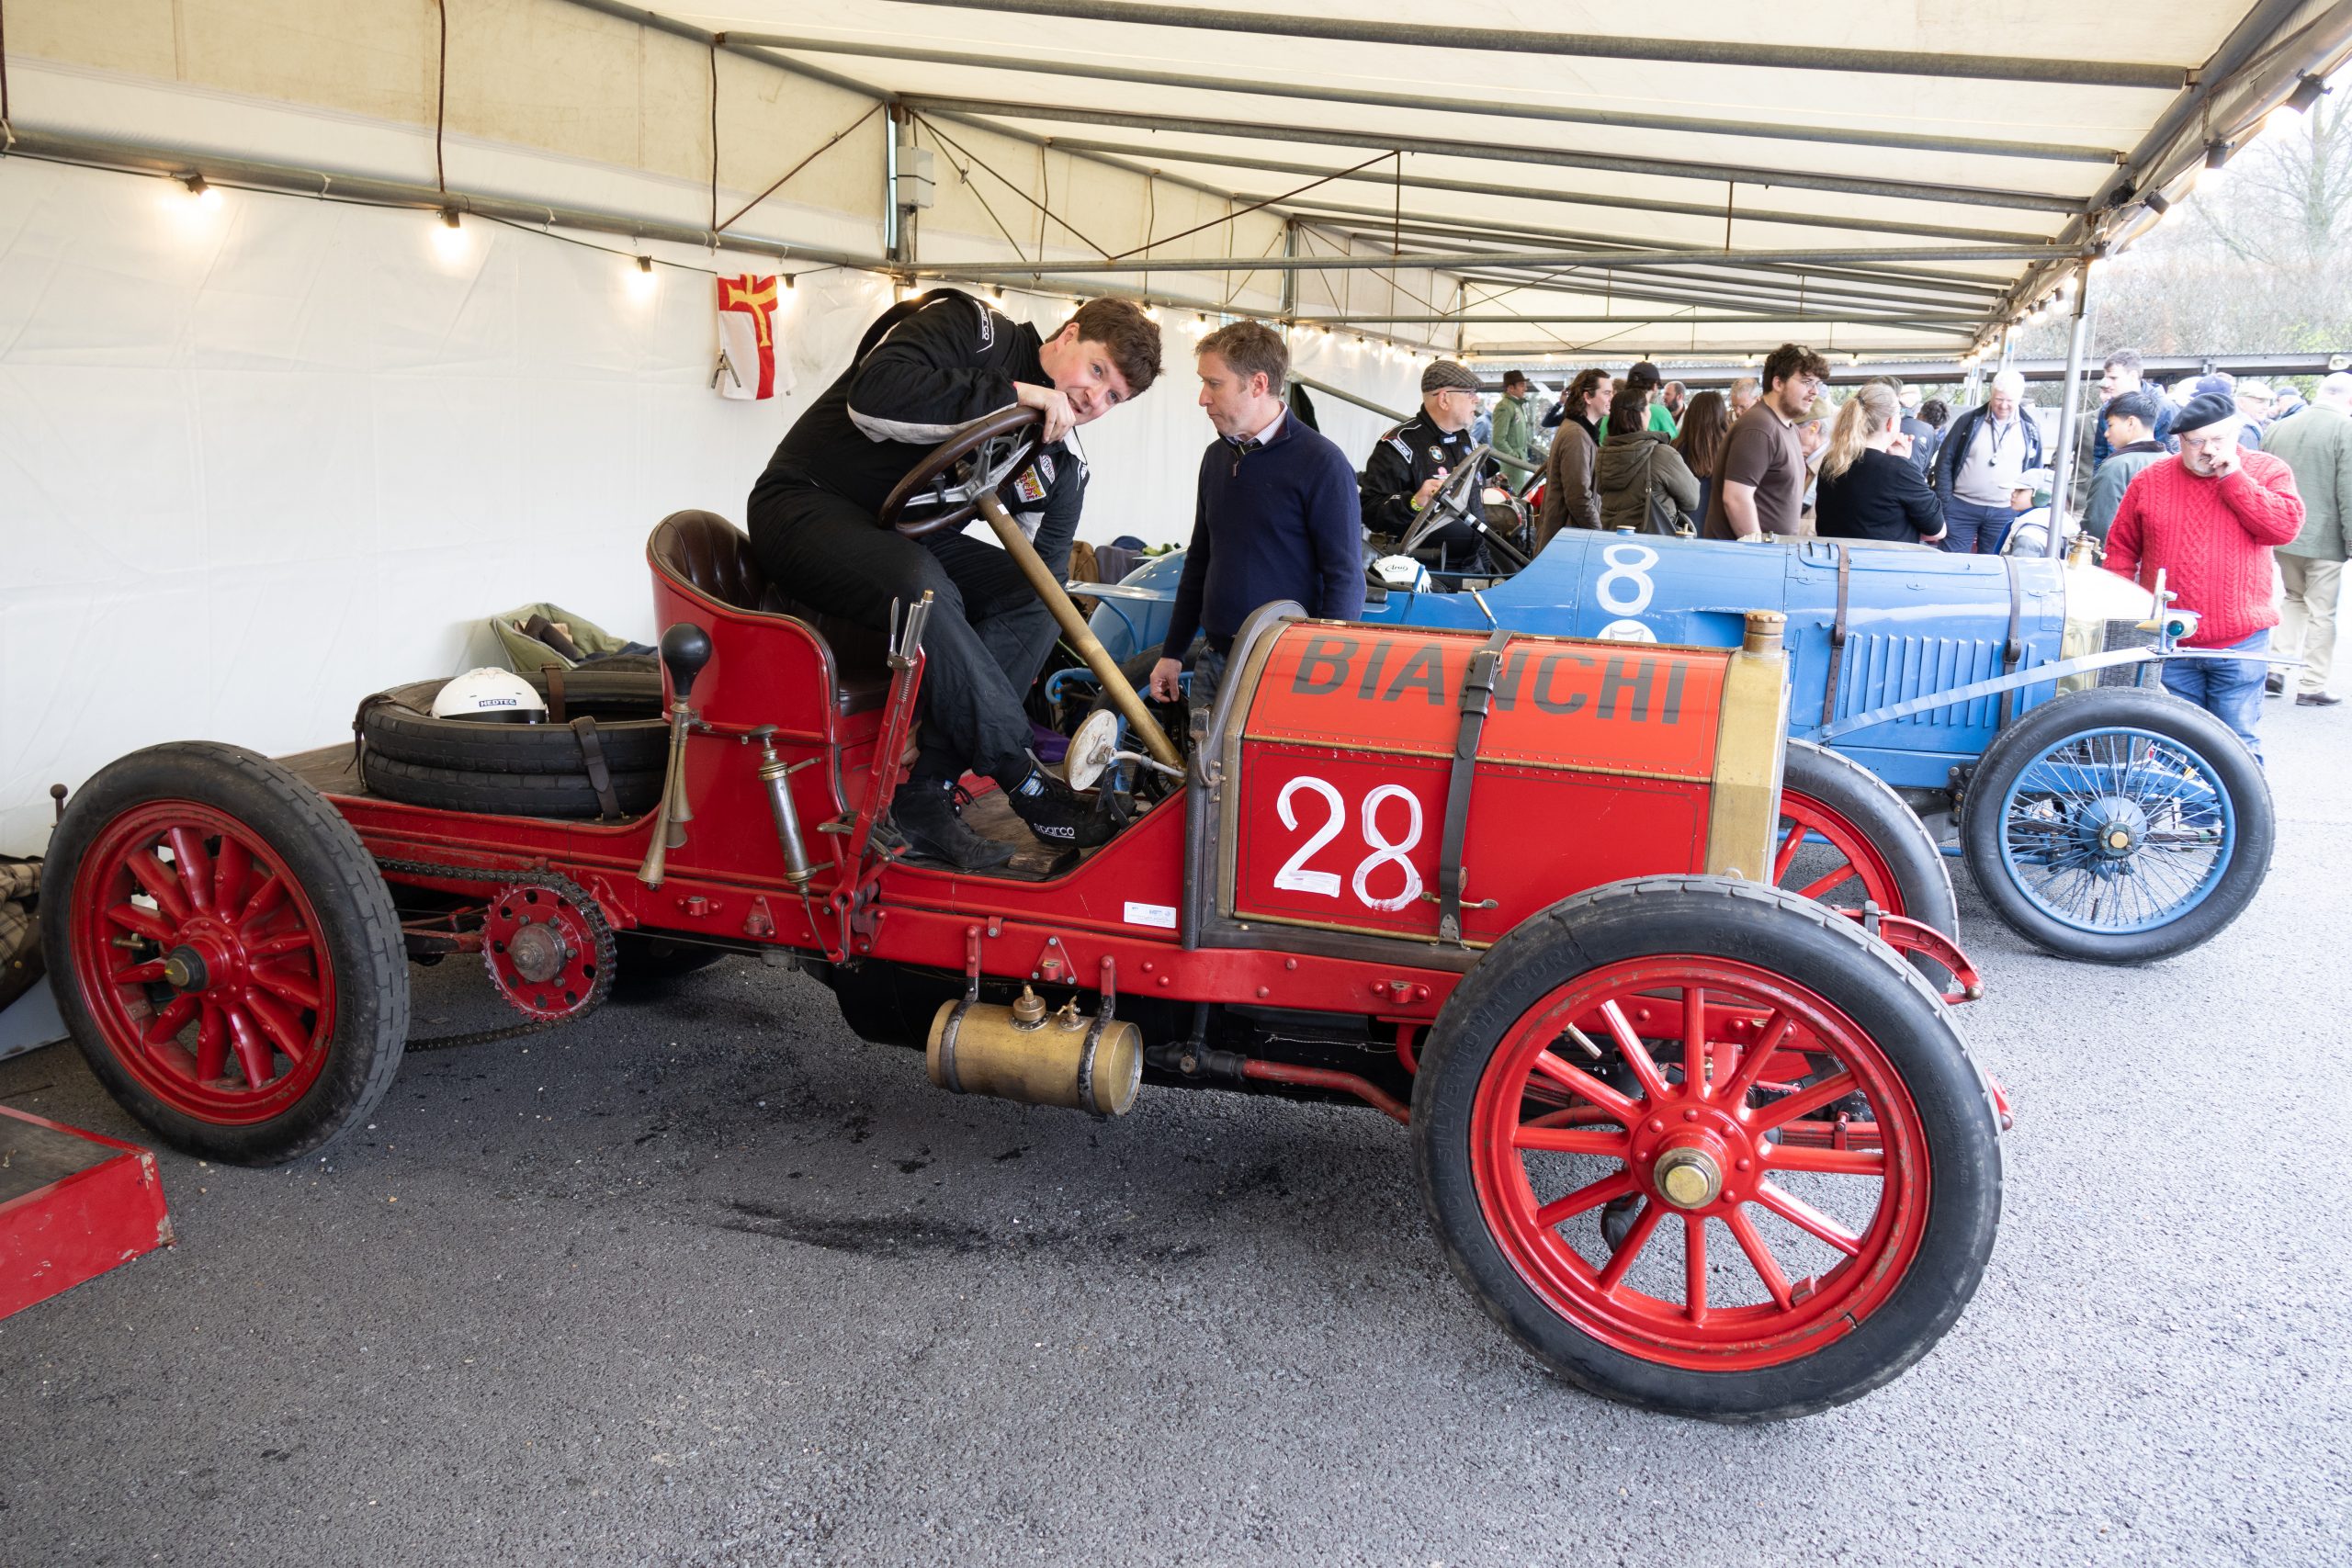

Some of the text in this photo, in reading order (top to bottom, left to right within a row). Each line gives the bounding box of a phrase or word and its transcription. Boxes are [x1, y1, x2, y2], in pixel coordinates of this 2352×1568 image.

[1596, 543, 1659, 615] 8
[1291, 636, 1689, 725] BIANCHI
[1273, 775, 1423, 912] 28
